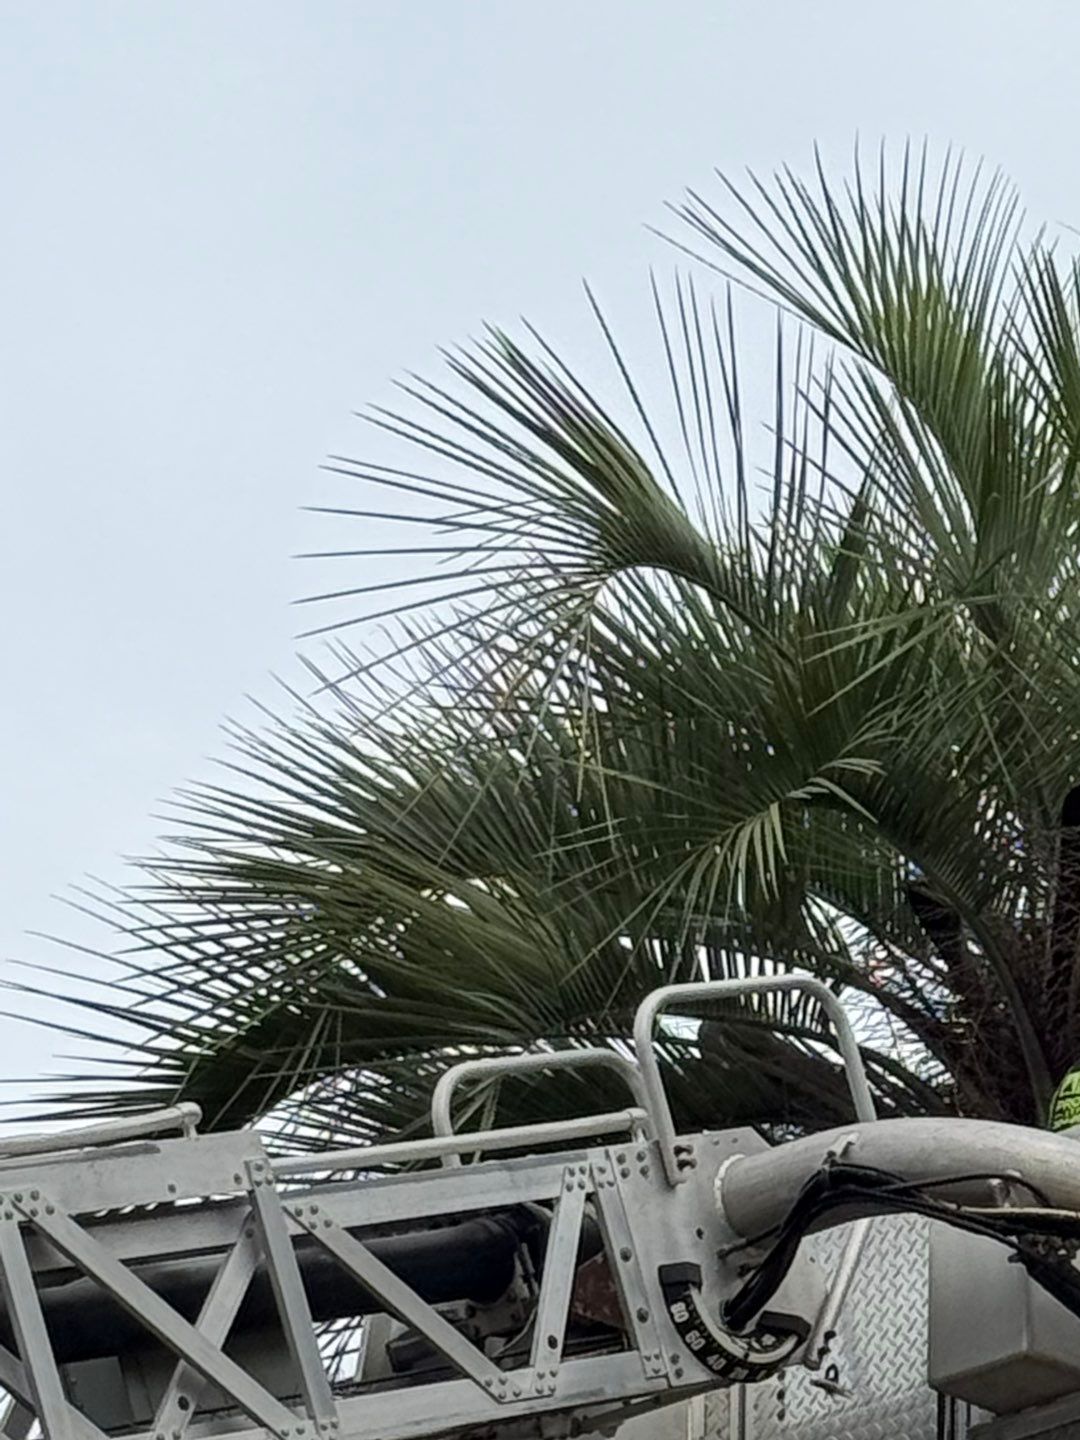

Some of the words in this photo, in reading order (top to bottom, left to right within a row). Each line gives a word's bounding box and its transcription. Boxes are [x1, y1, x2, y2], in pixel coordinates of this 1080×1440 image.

[670, 1301, 690, 1323] 80
[684, 1330, 706, 1351] 60
[706, 1354, 727, 1371] 40
